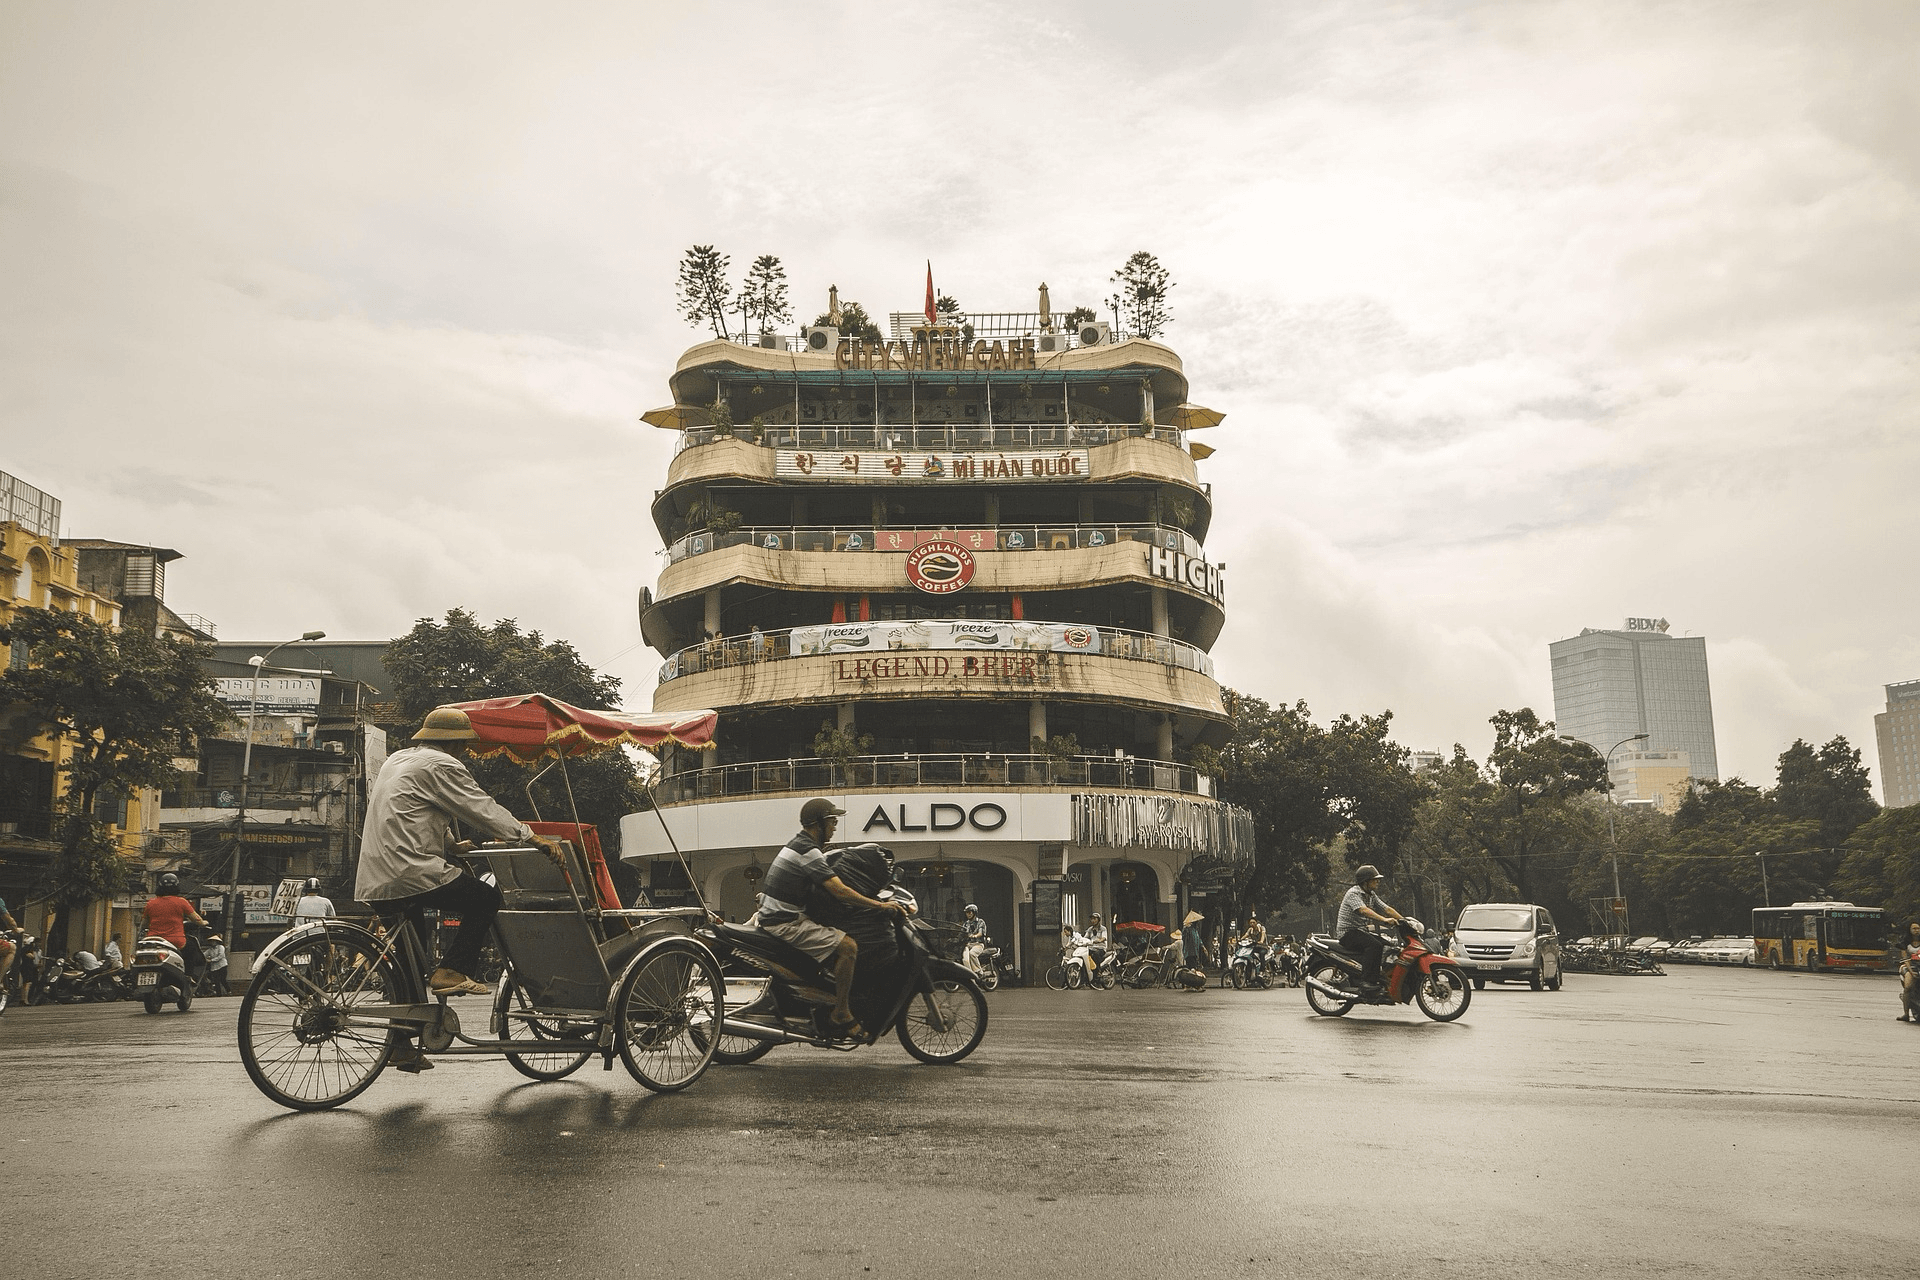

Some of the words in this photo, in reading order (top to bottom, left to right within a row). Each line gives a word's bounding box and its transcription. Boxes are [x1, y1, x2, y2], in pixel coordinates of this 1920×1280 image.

[836, 339, 894, 370] CITY
[902, 339, 970, 370] VIEW
[973, 338, 1036, 370] CAFE
[795, 453, 906, 476] 한식당
[952, 455, 976, 478] MÌ
[983, 453, 1023, 478] HÀN
[1031, 451, 1081, 476] QUỐC
[909, 544, 972, 566] HIGHLANDS
[916, 578, 965, 592] COFFEE
[822, 627, 864, 638] freeze
[950, 623, 993, 634] freeze
[1628, 617, 1657, 631] BIDV
[838, 656, 950, 680] LEGEND
[962, 656, 1036, 678] BEER
[862, 802, 1008, 831] ALDO
[1138, 825, 1190, 838] SWAROVSKI
